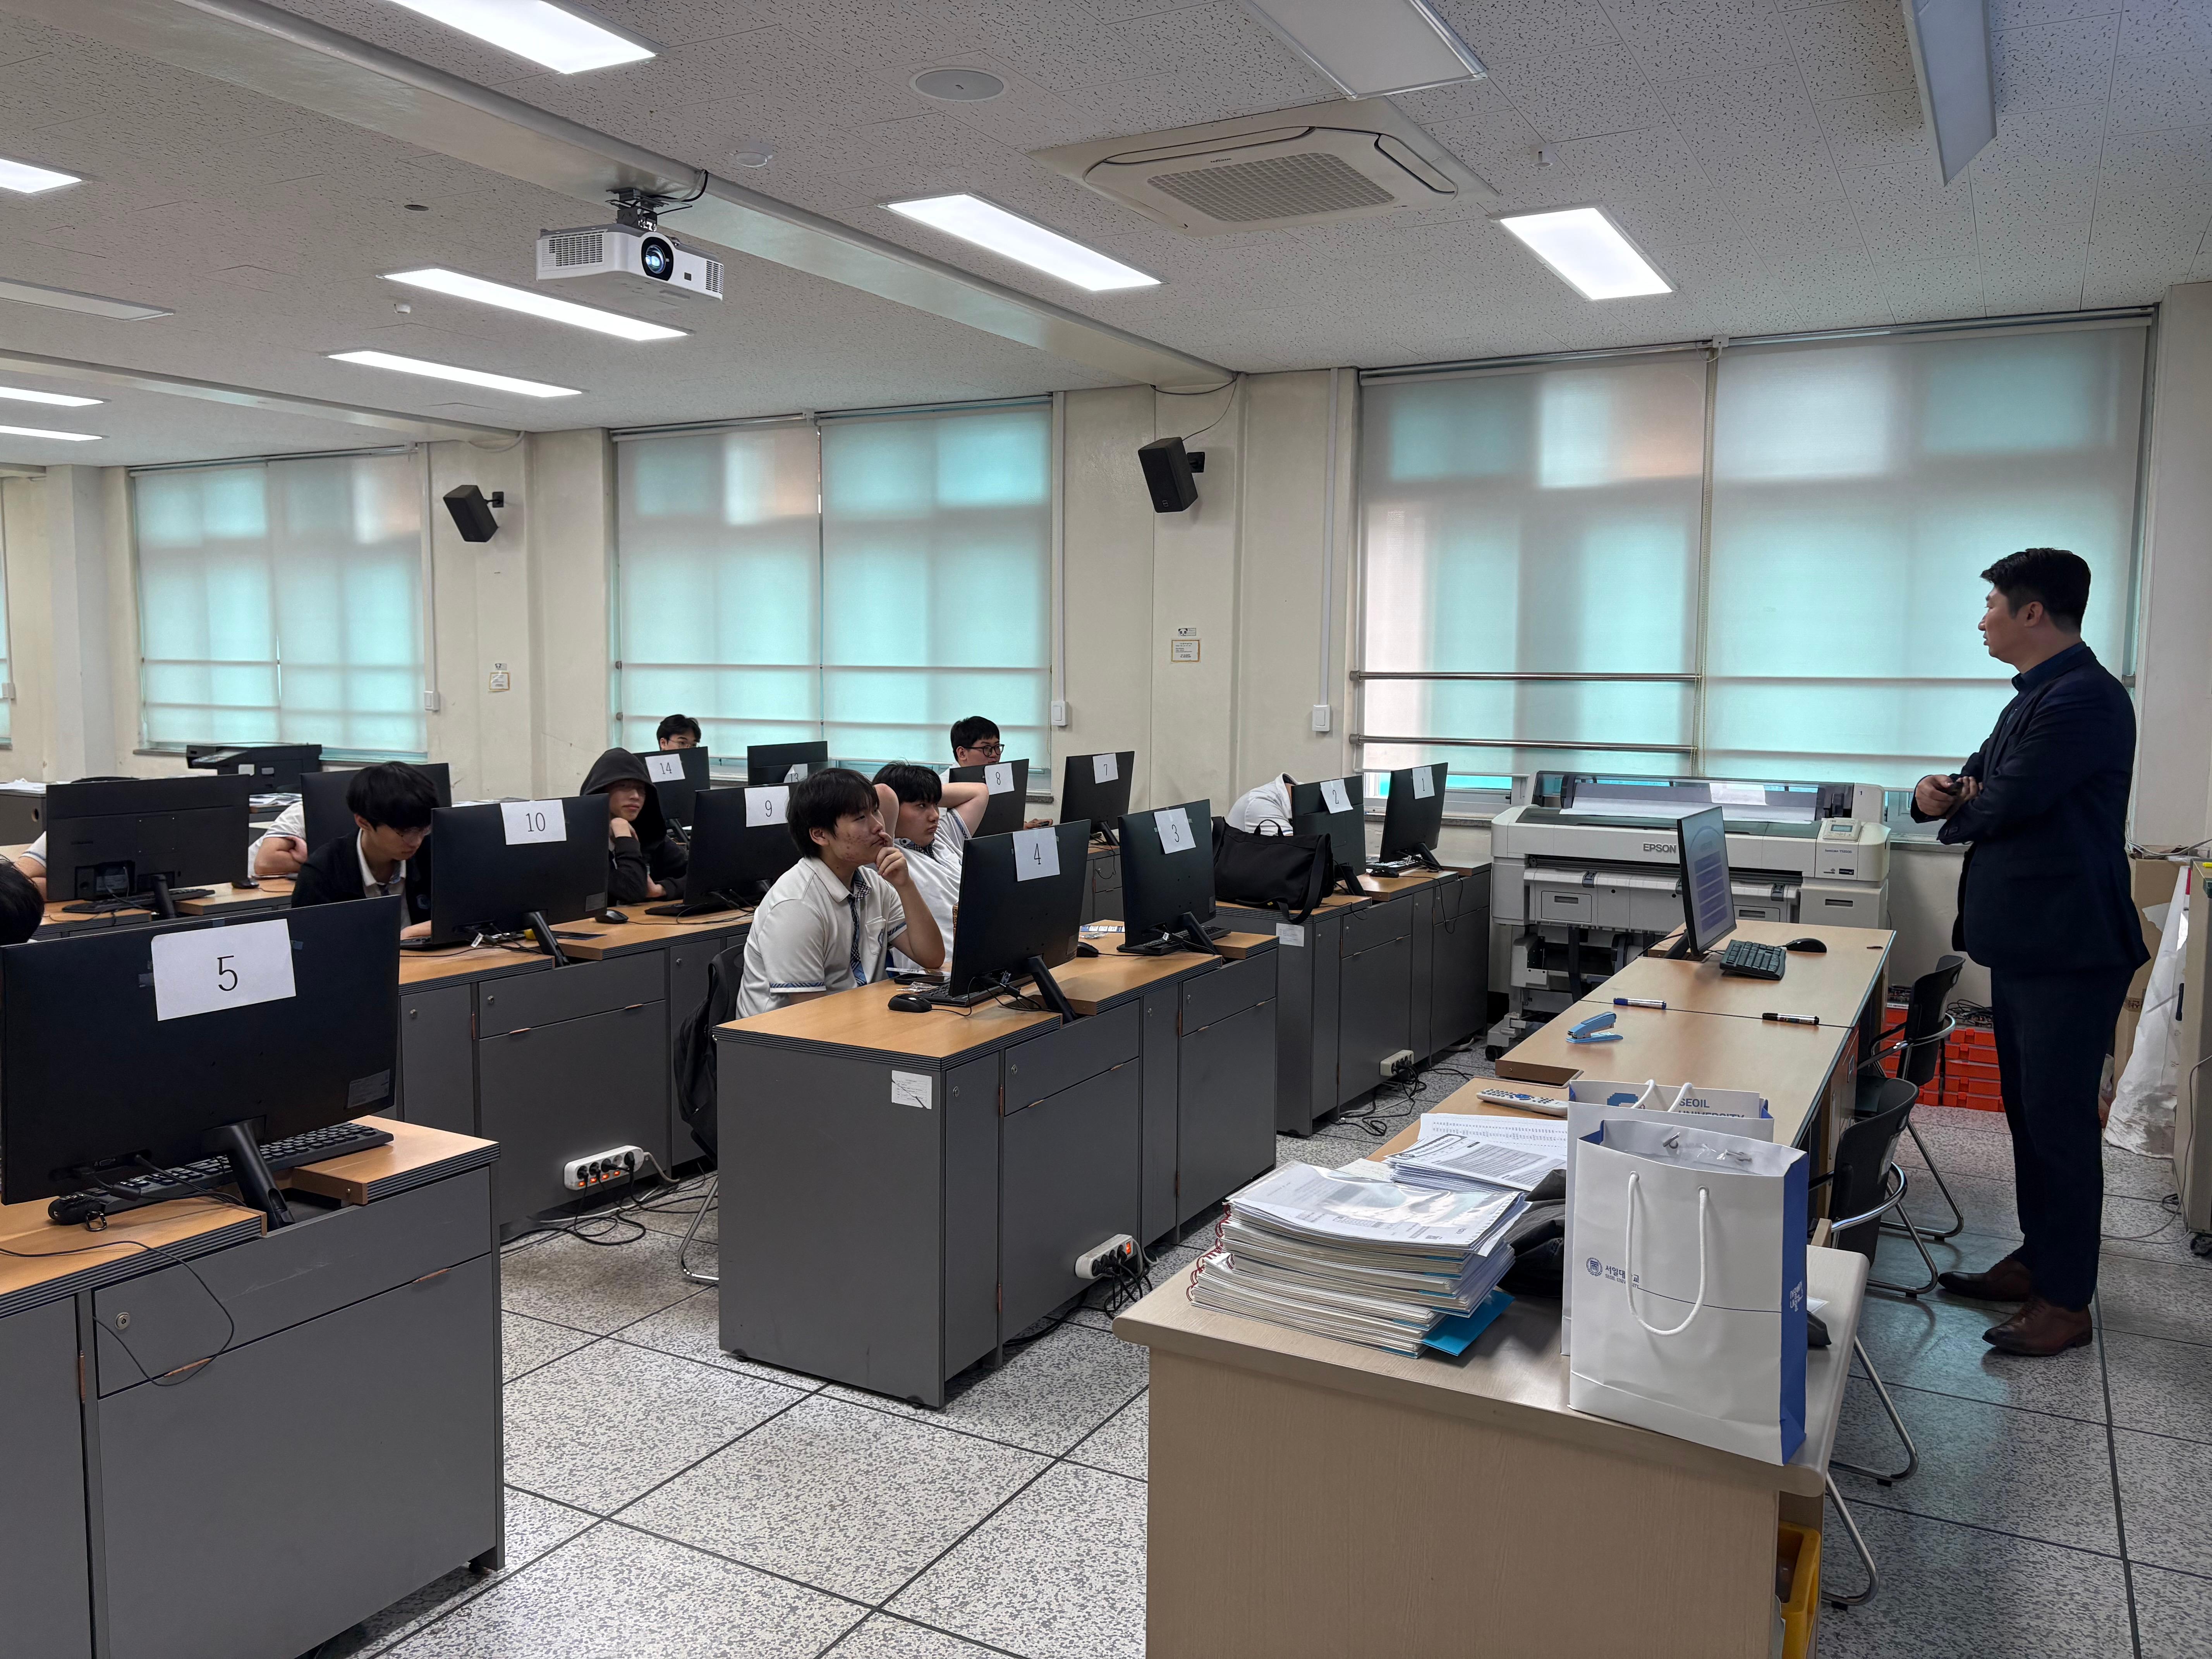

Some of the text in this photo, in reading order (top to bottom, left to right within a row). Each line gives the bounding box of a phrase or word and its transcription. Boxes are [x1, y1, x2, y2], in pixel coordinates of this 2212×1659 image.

[660, 762, 672, 775] 14
[1104, 764, 1108, 776] 7
[791, 773, 799, 783] 13
[995, 772, 1001, 785] 8
[1422, 778, 1425, 791] 1
[1333, 790, 1339, 804] 2
[765, 800, 772, 817] 9
[526, 812, 546, 832] 10
[1171, 824, 1180, 842] 3
[1034, 843, 1041, 865] 4
[1643, 843, 1676, 853] EPSON
[217, 955, 238, 991] 5
[1679, 1098, 1710, 1108] SEOIL
[1605, 1265, 1639, 1283] 서일대교
[1617, 1278, 1639, 1288] UNIVITY
